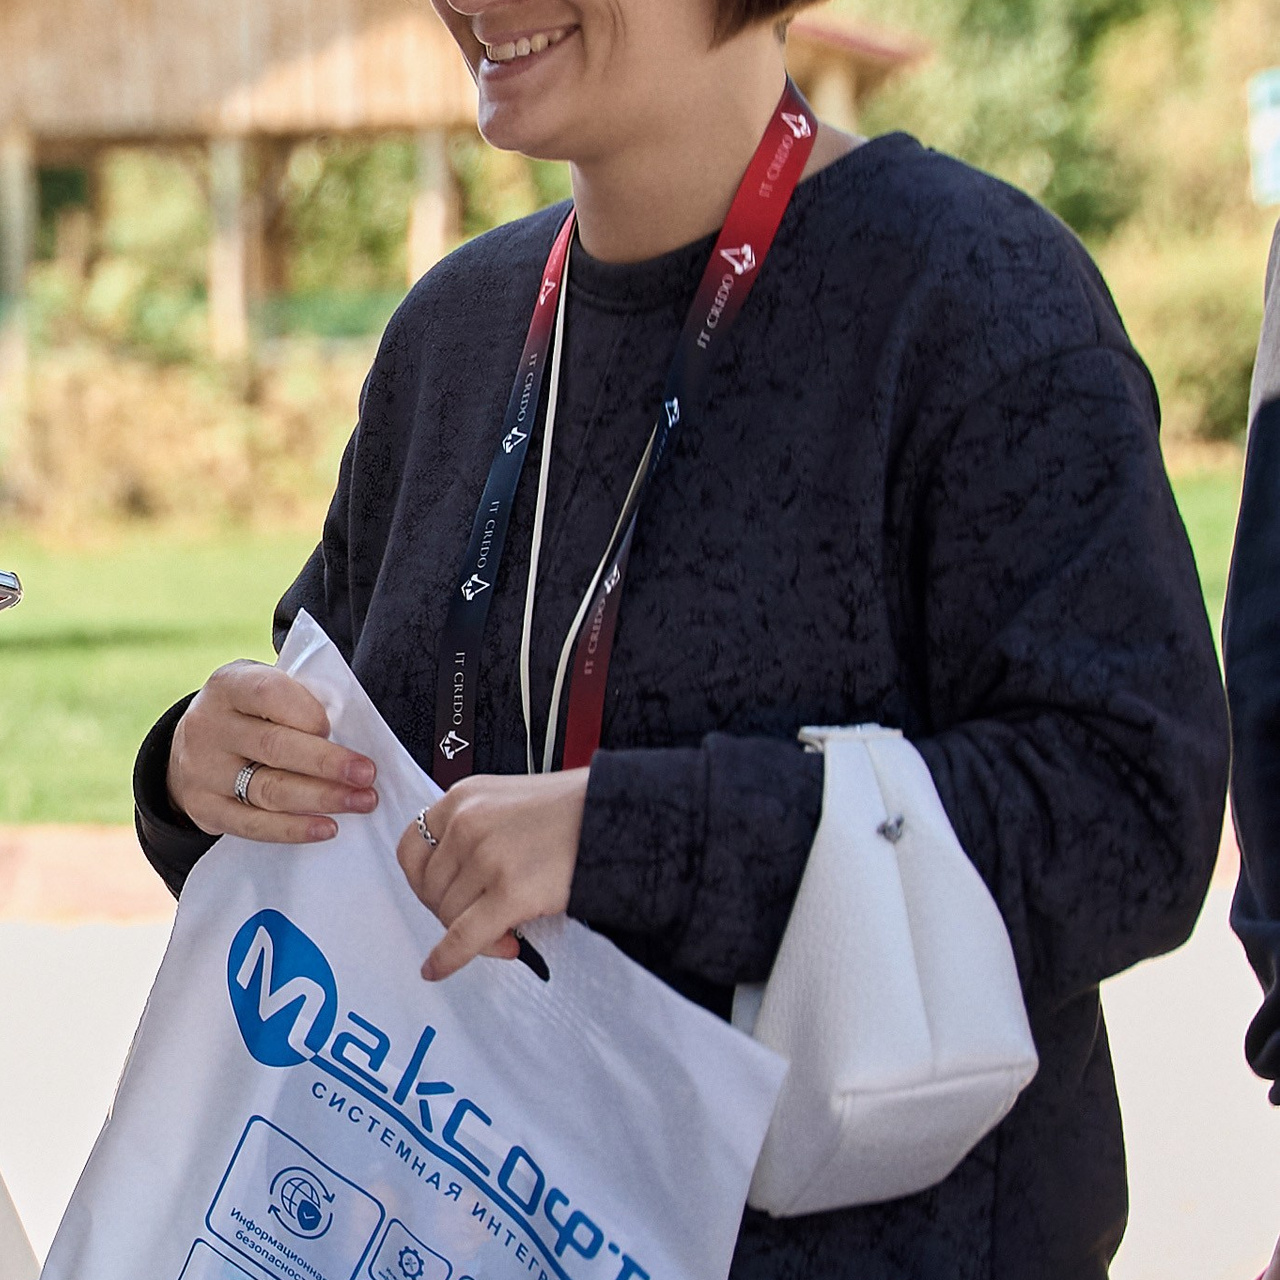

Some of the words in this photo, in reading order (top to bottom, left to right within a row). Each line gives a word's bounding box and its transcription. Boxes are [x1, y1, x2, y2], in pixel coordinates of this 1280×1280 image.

[529, 352, 539, 367] IT
[517, 371, 535, 422] CREDO
[488, 500, 500, 515] IT
[476, 519, 496, 569] CREDO
[455, 651, 465, 667] IT
[452, 671, 465, 726] CREDO
[312, 1081, 462, 1203] СИСТЕМНАЯ
